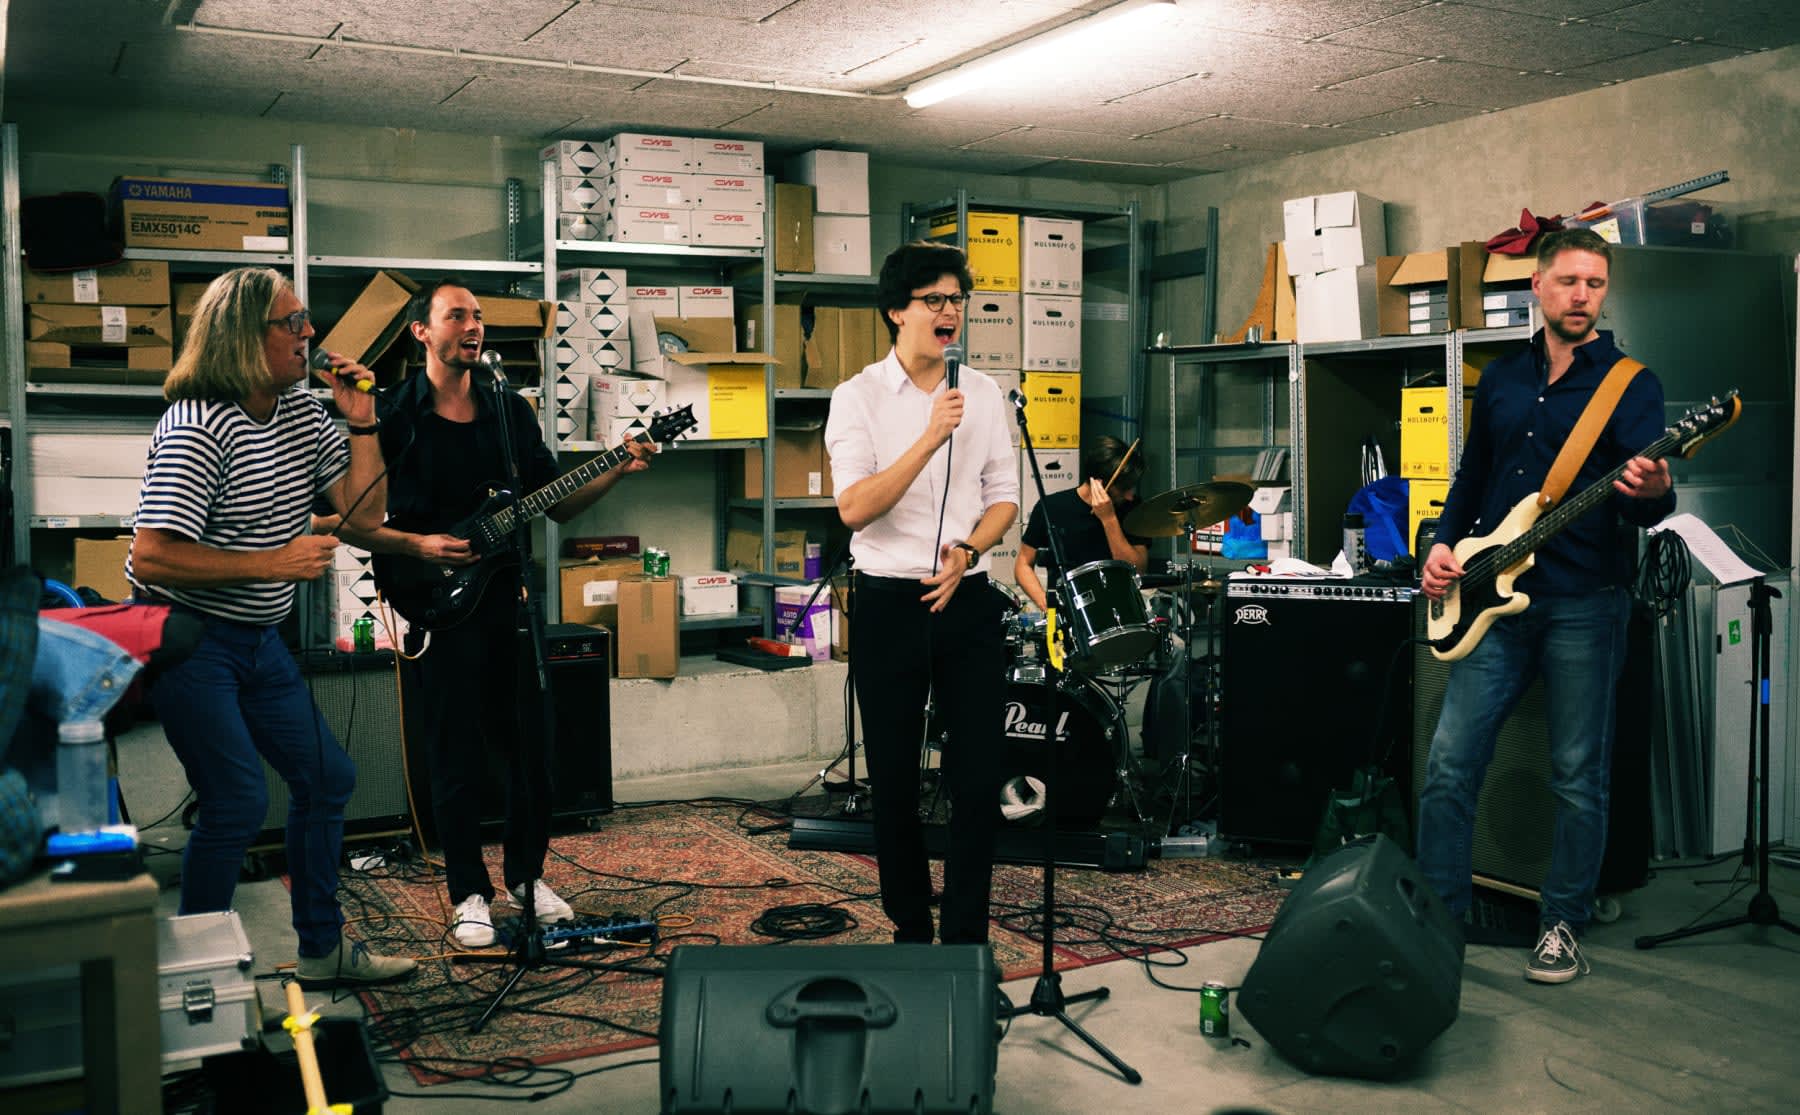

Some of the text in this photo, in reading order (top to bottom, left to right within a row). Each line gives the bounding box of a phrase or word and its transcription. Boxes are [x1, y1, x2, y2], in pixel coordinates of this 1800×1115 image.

[641, 138, 673, 147] CWS
[713, 143, 745, 151] CWS
[641, 175, 673, 183] CWS
[713, 179, 745, 187] CWS
[143, 184, 192, 199] YAMAHA
[639, 211, 670, 219] CWS
[713, 214, 744, 222] CWS
[131, 221, 201, 235] EMX5014C
[636, 288, 667, 296] CWS
[697, 576, 728, 585] CWS
